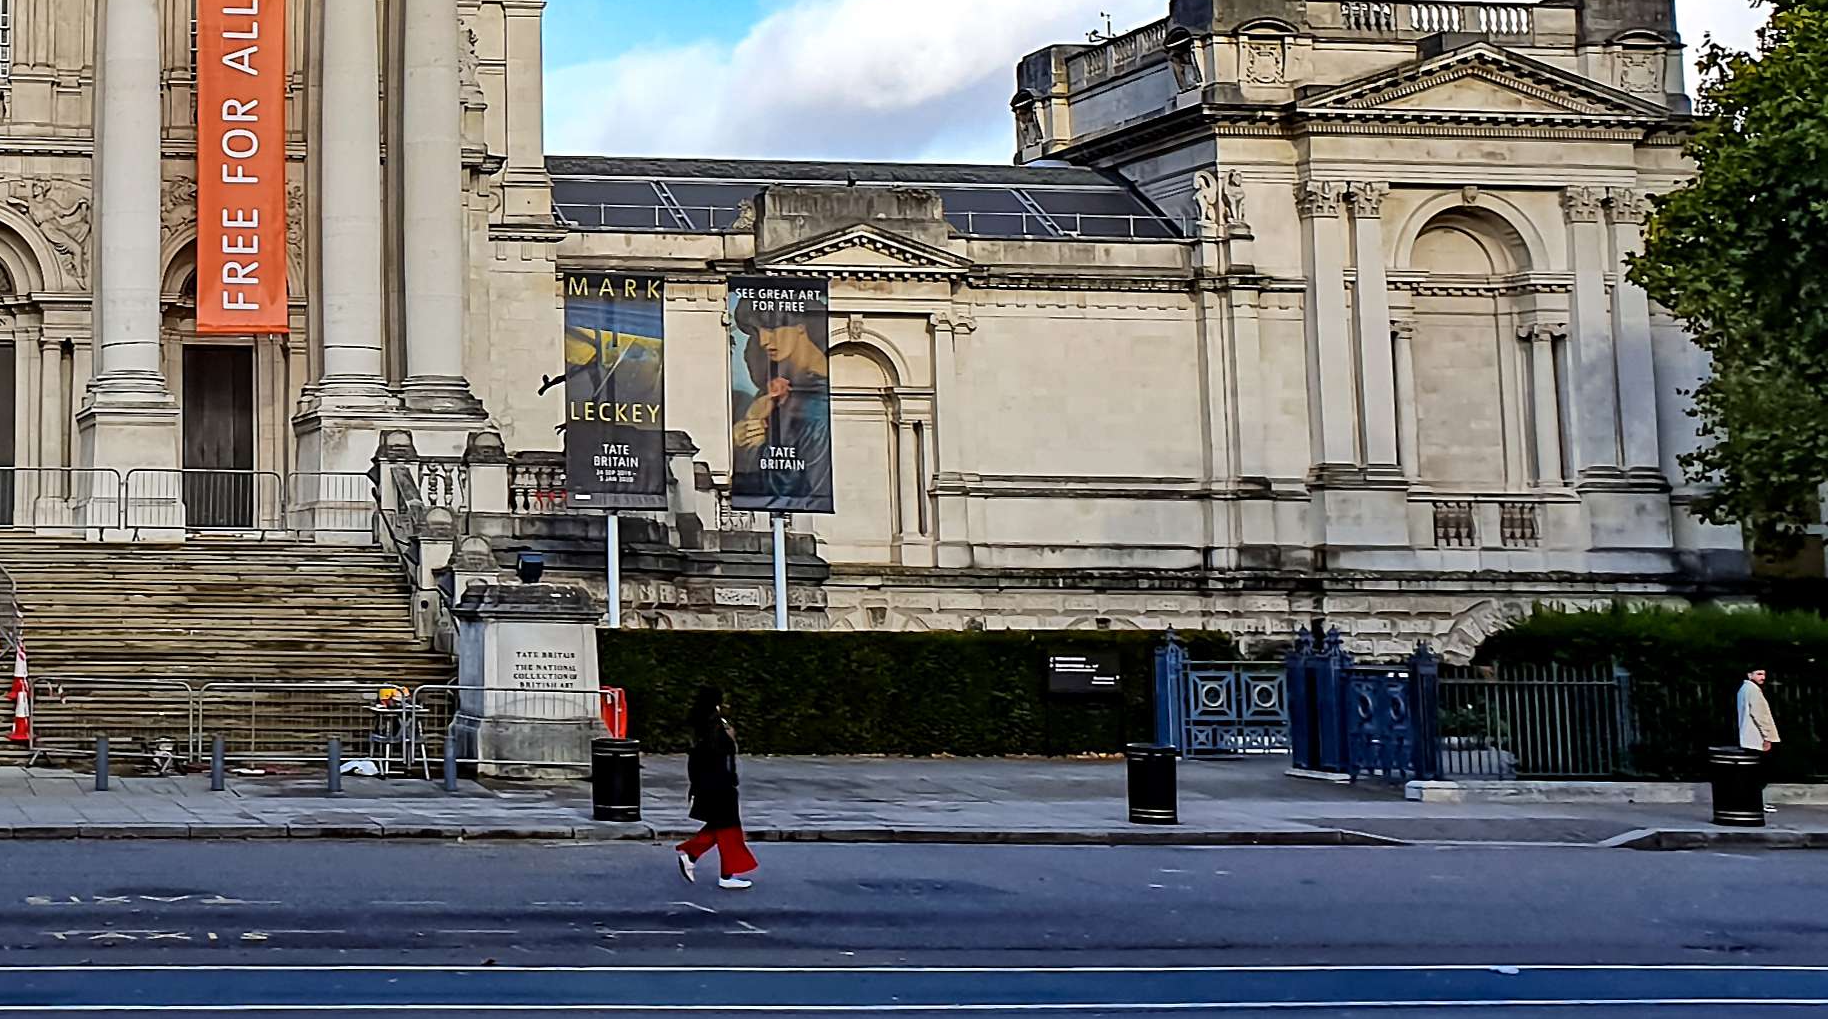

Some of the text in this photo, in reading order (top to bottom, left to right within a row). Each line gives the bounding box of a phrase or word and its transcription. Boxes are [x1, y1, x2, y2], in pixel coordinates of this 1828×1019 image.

[221, 98, 259, 183] FOR
[222, 208, 260, 310] FREE
[568, 276, 661, 299] MARK
[735, 287, 821, 301] SEE GREAT ART
[752, 300, 805, 313] FOR FREE
[570, 401, 661, 423] LECKEY
[602, 443, 630, 455] TATE
[769, 445, 796, 458] TATE
[593, 455, 639, 468] BRITAIN
[760, 458, 805, 470] BRITAIN
[516, 651, 539, 659] TATE
[536, 664, 576, 672] NATIONAL
